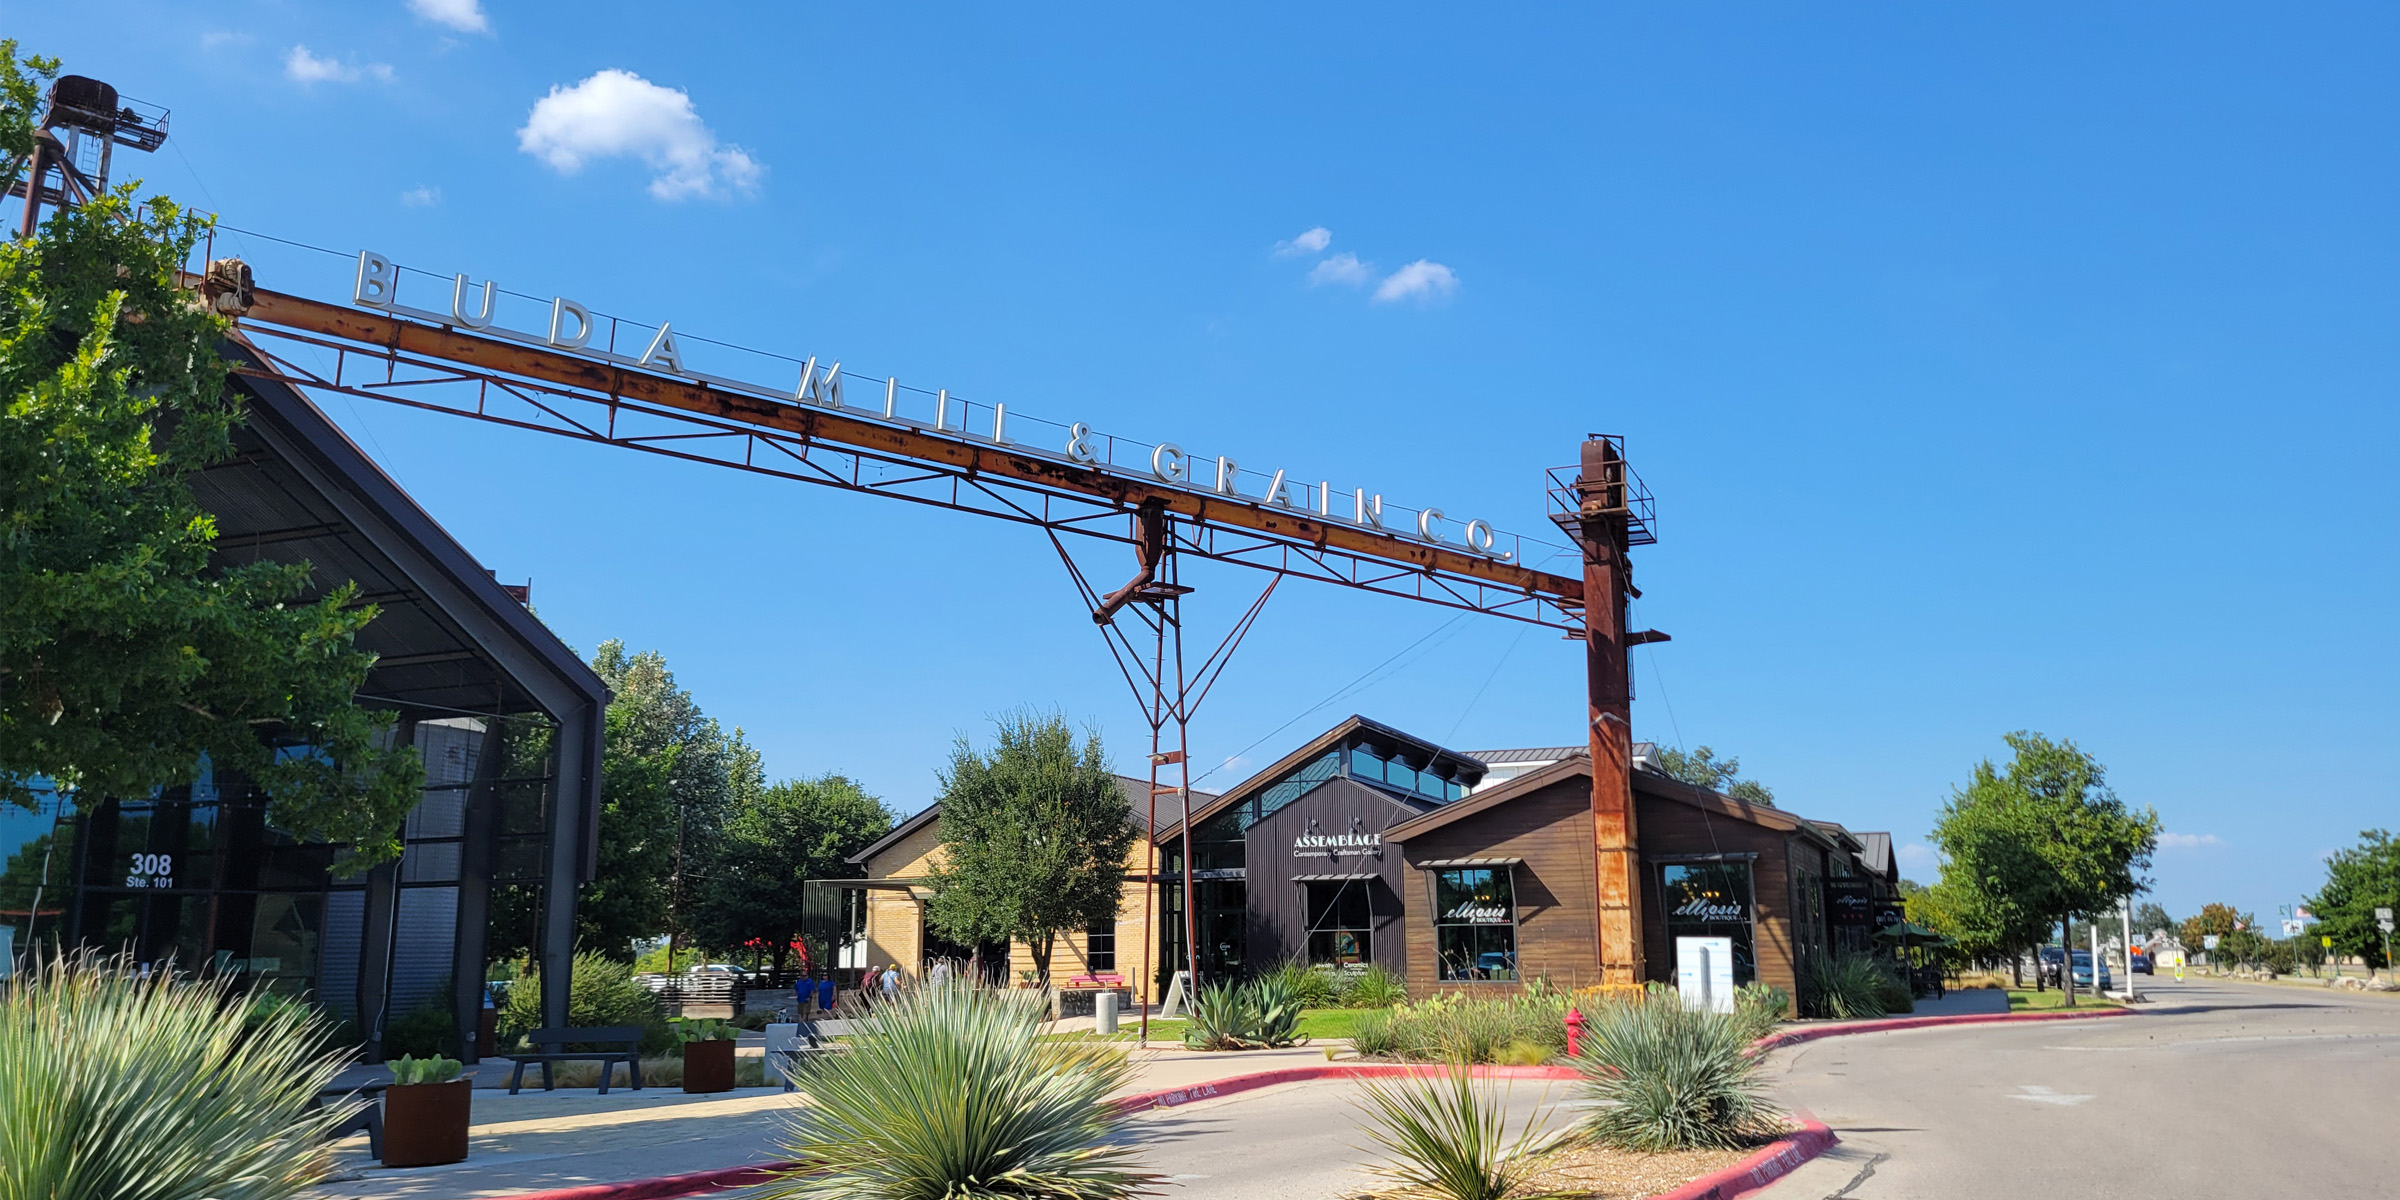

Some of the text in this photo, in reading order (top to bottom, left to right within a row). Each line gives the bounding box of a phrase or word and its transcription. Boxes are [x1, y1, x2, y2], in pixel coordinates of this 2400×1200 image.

[353, 249, 1514, 560] BUDA MILL & GRAIN CO.
[1294, 834, 1382, 847] ASSEMBLAGE
[130, 853, 172, 876] 308
[1293, 847, 1382, 859] Contemporary Craftsman Gallery
[126, 876, 173, 889] Ste. 101
[1443, 901, 1507, 924] ellipsis
[1672, 898, 1742, 922] ellipsis
